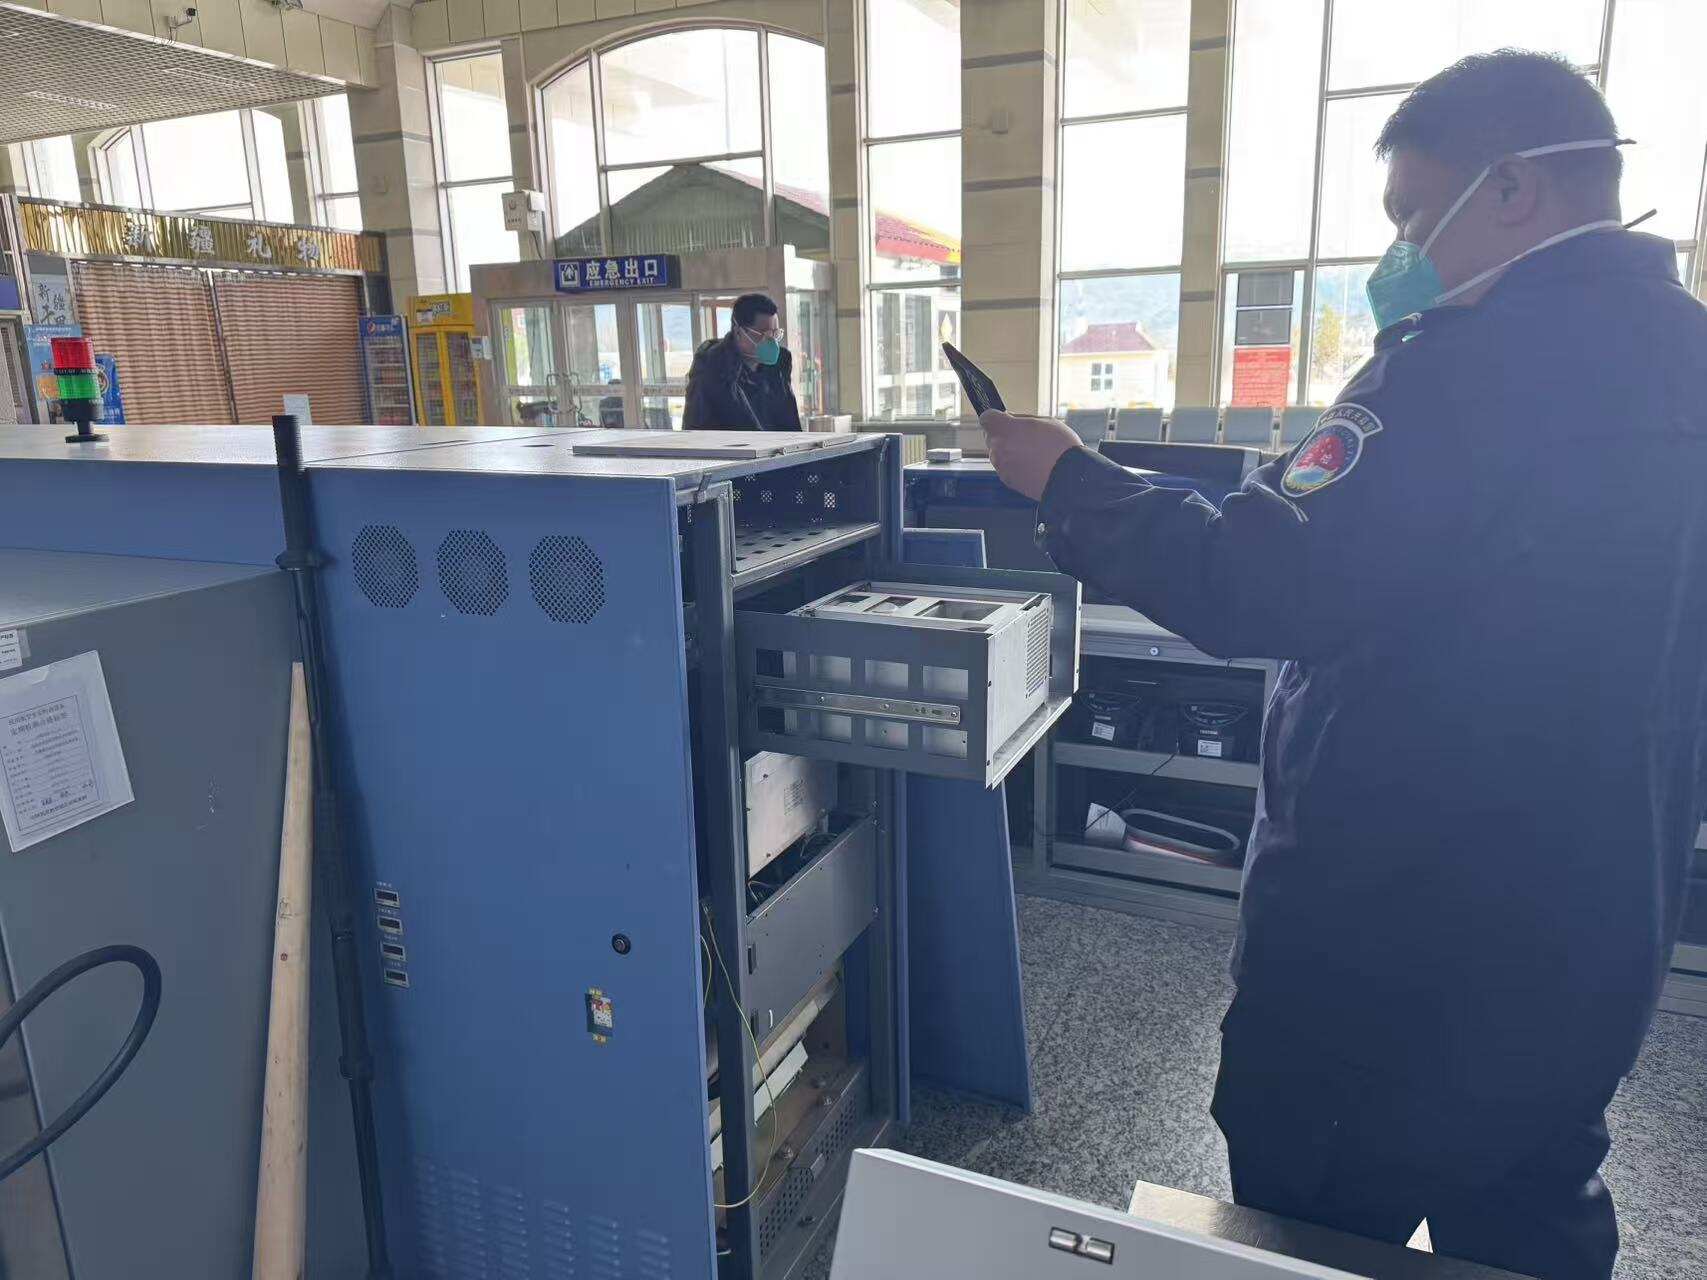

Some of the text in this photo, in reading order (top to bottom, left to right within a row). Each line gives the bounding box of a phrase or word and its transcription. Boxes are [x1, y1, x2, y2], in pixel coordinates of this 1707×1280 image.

[125, 219, 320, 262] 新疆礼物
[586, 257, 658, 280] 应急出口
[589, 277, 655, 288] EMERGENCY EXIT
